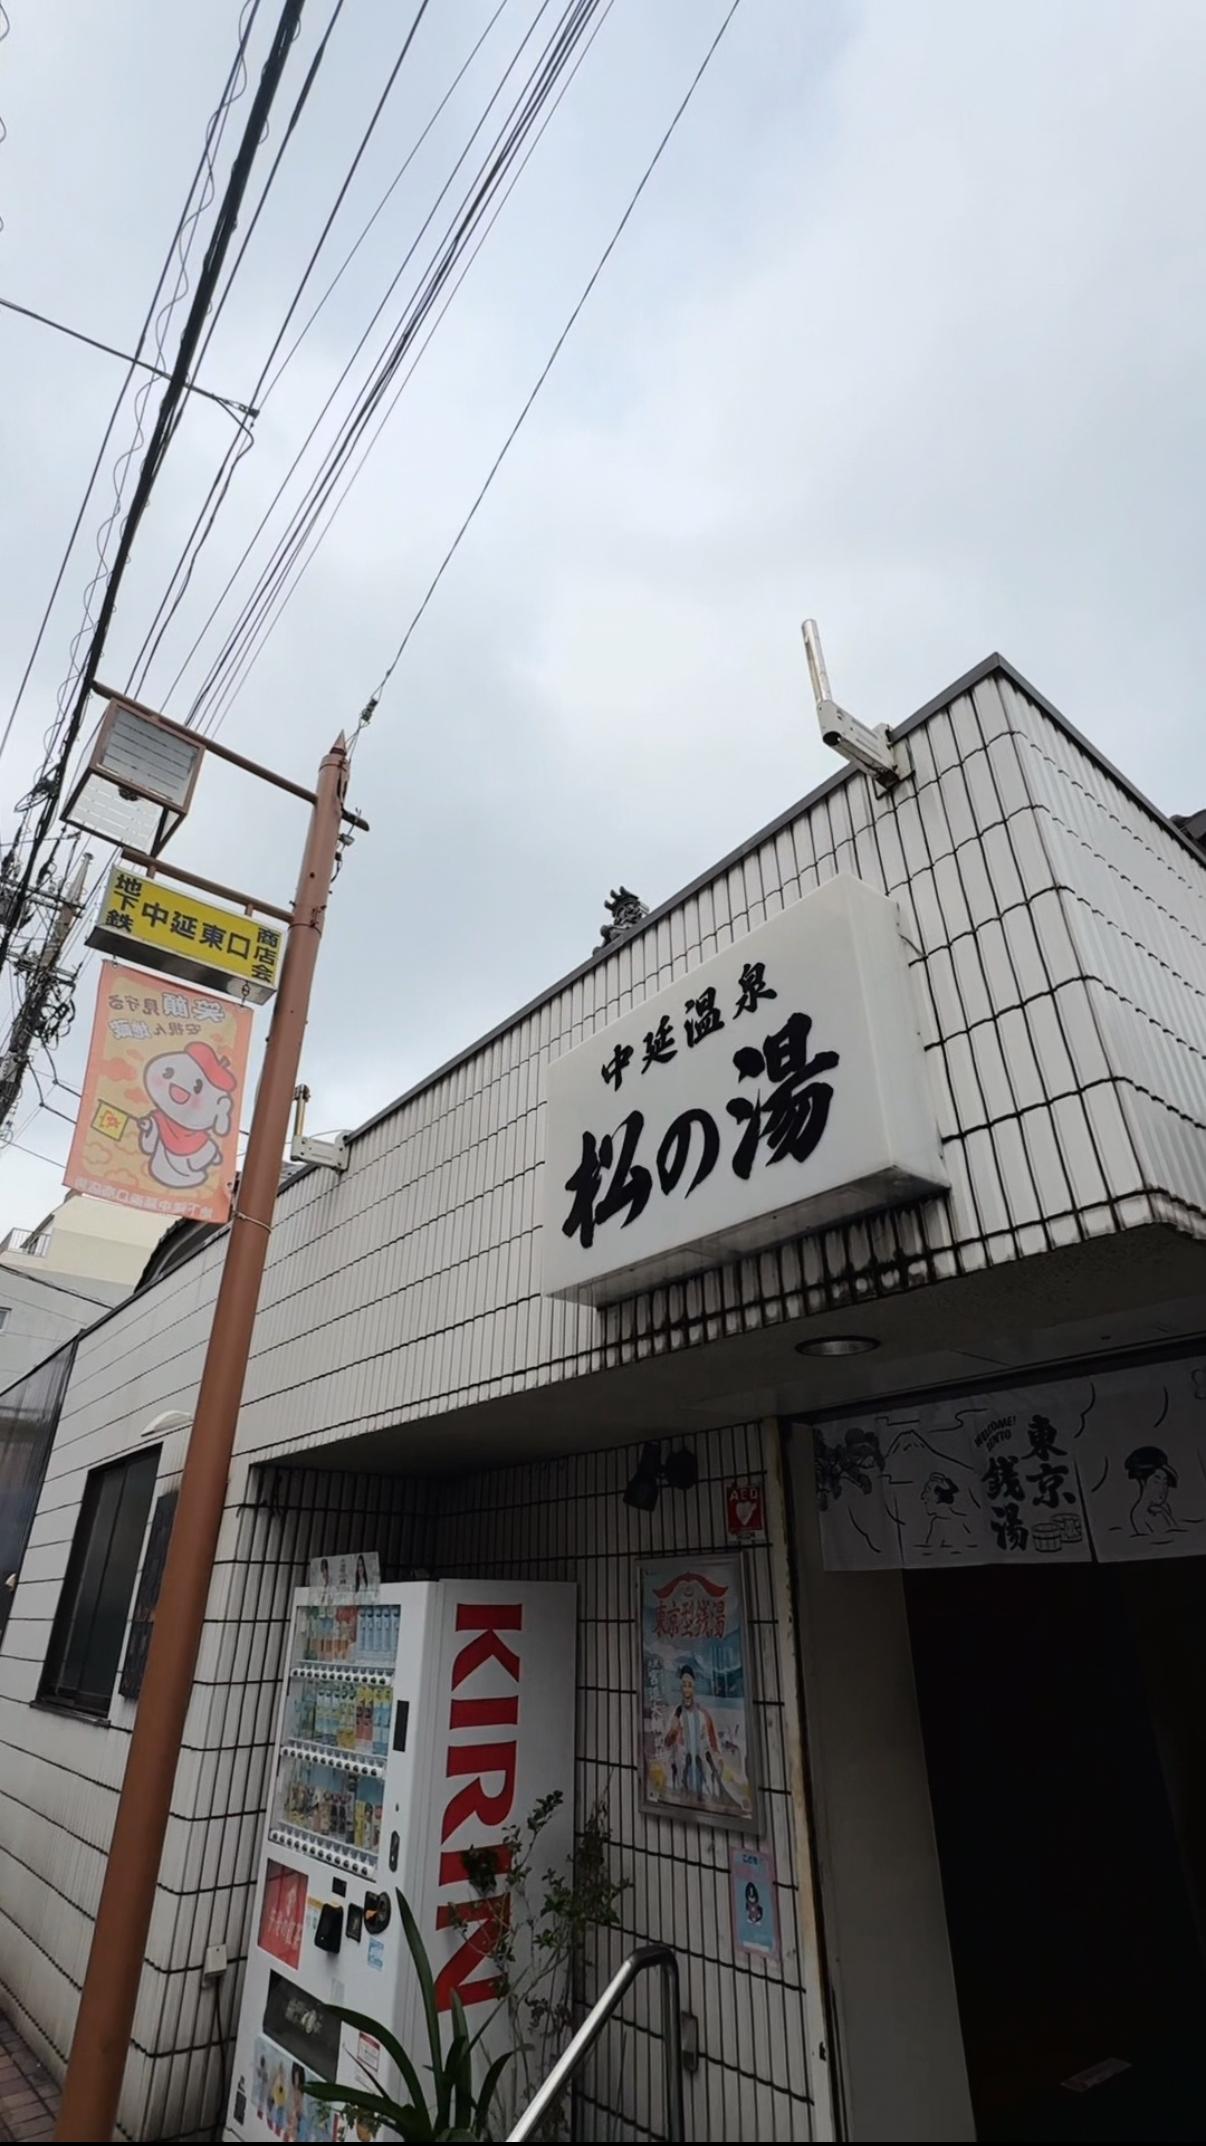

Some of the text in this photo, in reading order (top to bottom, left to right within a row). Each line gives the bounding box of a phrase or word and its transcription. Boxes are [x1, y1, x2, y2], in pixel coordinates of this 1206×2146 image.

[105, 874, 280, 983] 地下鉄 中延東口 商店会
[601, 961, 778, 1091] 中延温泉
[561, 1012, 839, 1249] 松の湯
[729, 1488, 758, 1501] AED
[981, 1455, 1029, 1551] 銭湯
[1021, 1414, 1076, 1508] 東京
[434, 1602, 524, 2013] KIRIN
